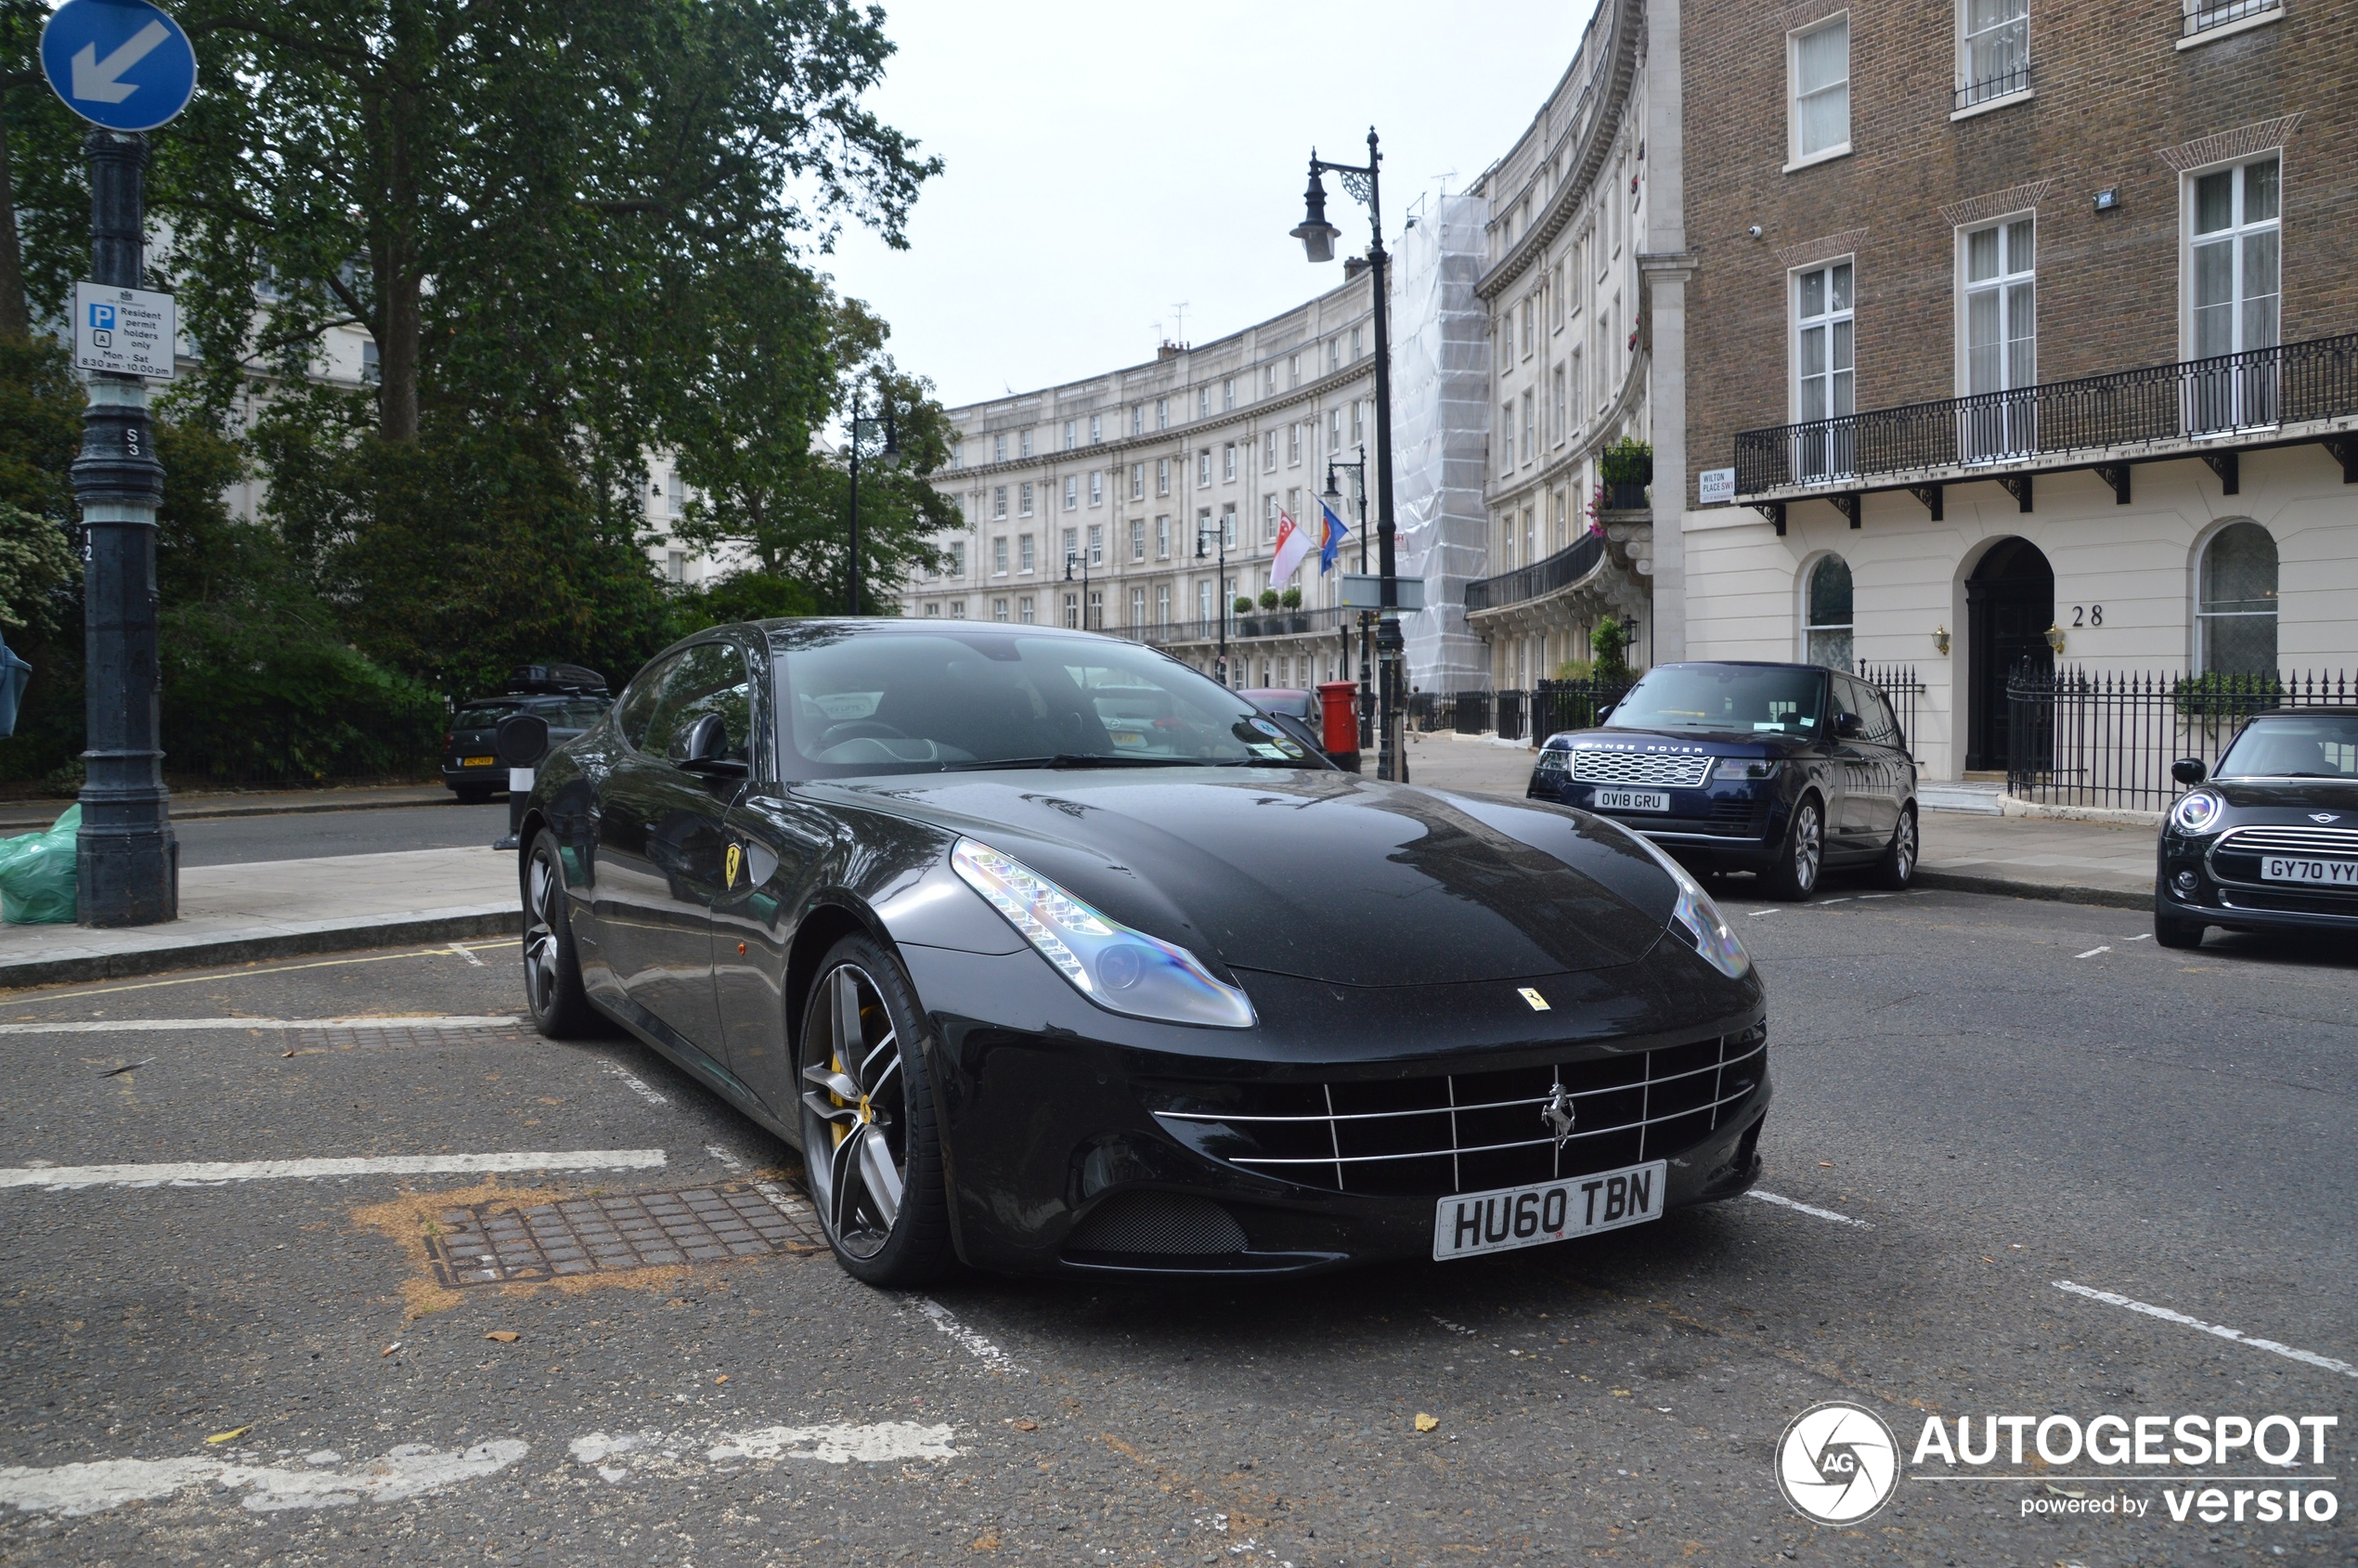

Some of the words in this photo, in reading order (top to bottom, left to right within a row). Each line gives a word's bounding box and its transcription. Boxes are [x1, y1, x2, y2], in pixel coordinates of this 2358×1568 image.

[95, 305, 112, 327] P
[121, 307, 162, 320] Resident
[125, 319, 157, 330] permit
[123, 328, 159, 340] holders
[131, 341, 151, 350] only
[103, 350, 123, 359] Mon
[133, 354, 149, 363] Sat
[82, 357, 104, 368] 8.30
[127, 363, 154, 373] 10.00
[1703, 473, 1725, 483] WILTON
[1703, 482, 1720, 492] PLACE
[1720, 481, 1733, 490] SW1
[2072, 604, 2103, 627] 28
[1601, 793, 1631, 806] OV18
[1634, 795, 1661, 808] GRU
[2271, 860, 2323, 879] GY70
[1454, 1187, 1567, 1250] HU60
[1581, 1170, 1652, 1226] TBN
